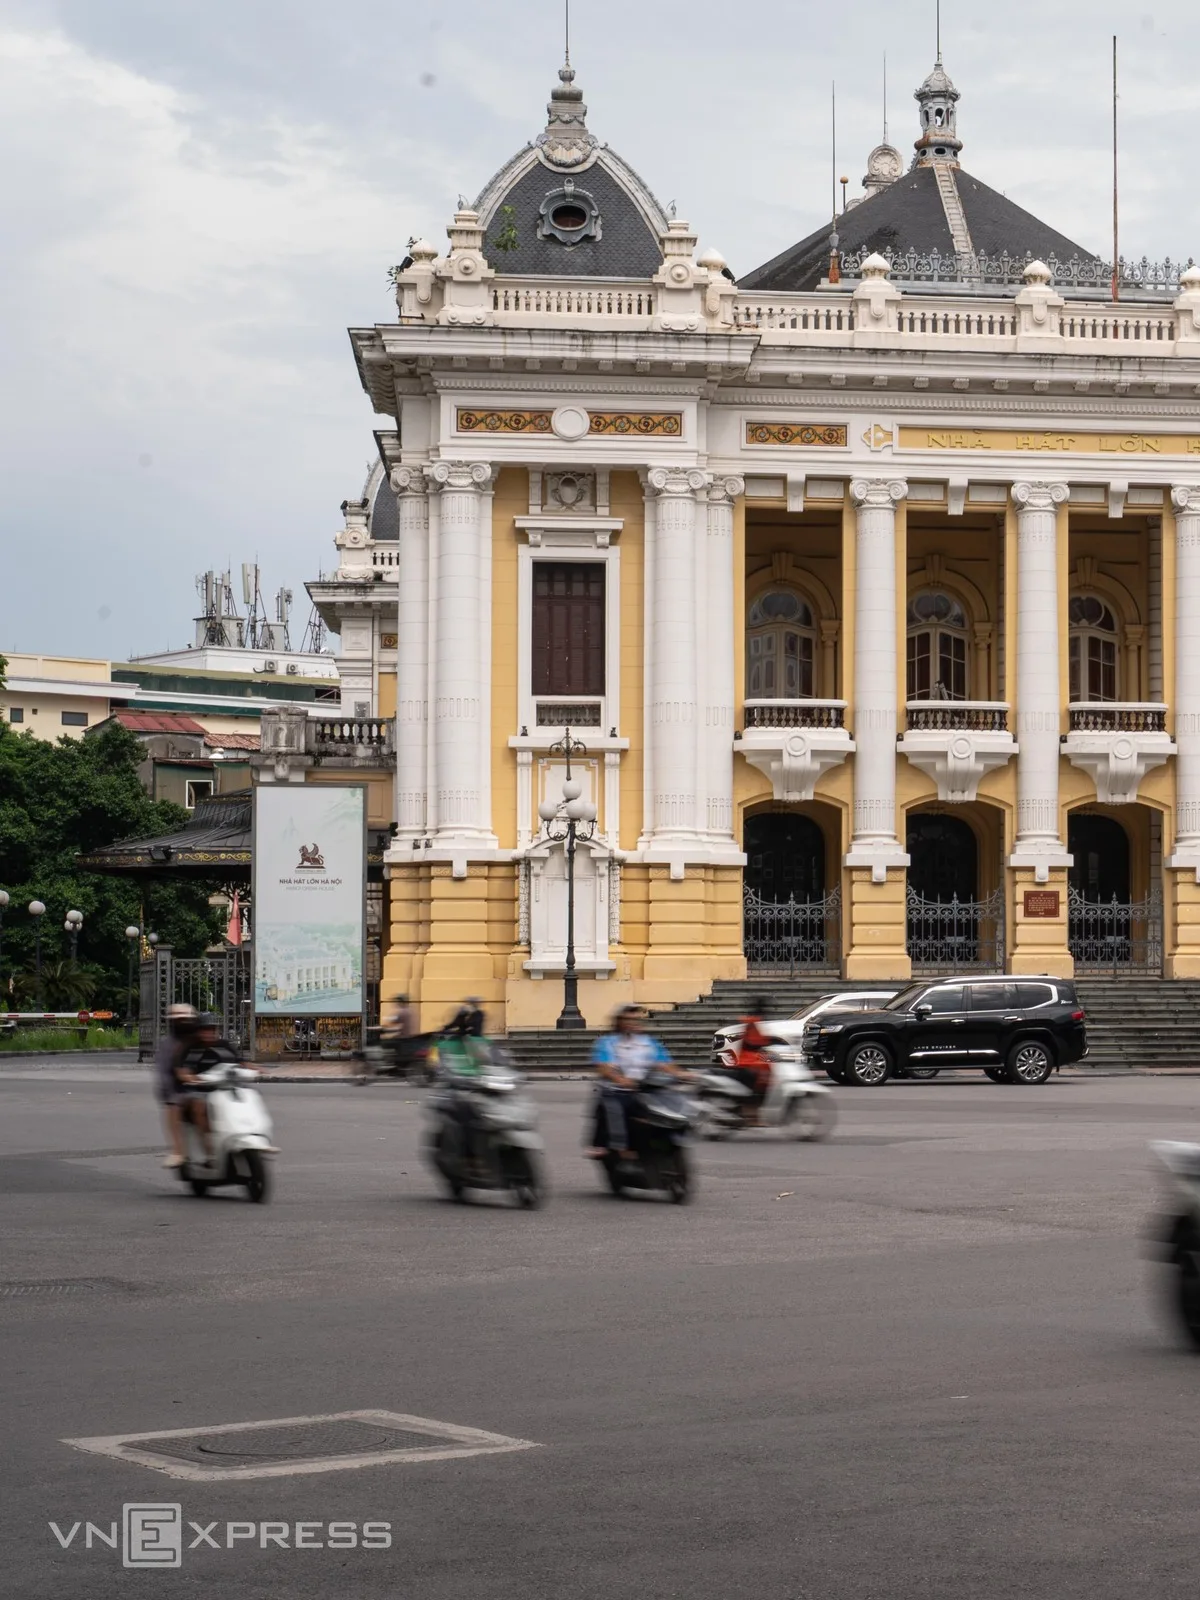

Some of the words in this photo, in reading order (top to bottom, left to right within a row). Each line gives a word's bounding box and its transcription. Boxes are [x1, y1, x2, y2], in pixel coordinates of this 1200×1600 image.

[927, 429, 991, 449] NHÀ
[1016, 431, 1076, 450] HÁT
[1098, 433, 1160, 453] LỚN
